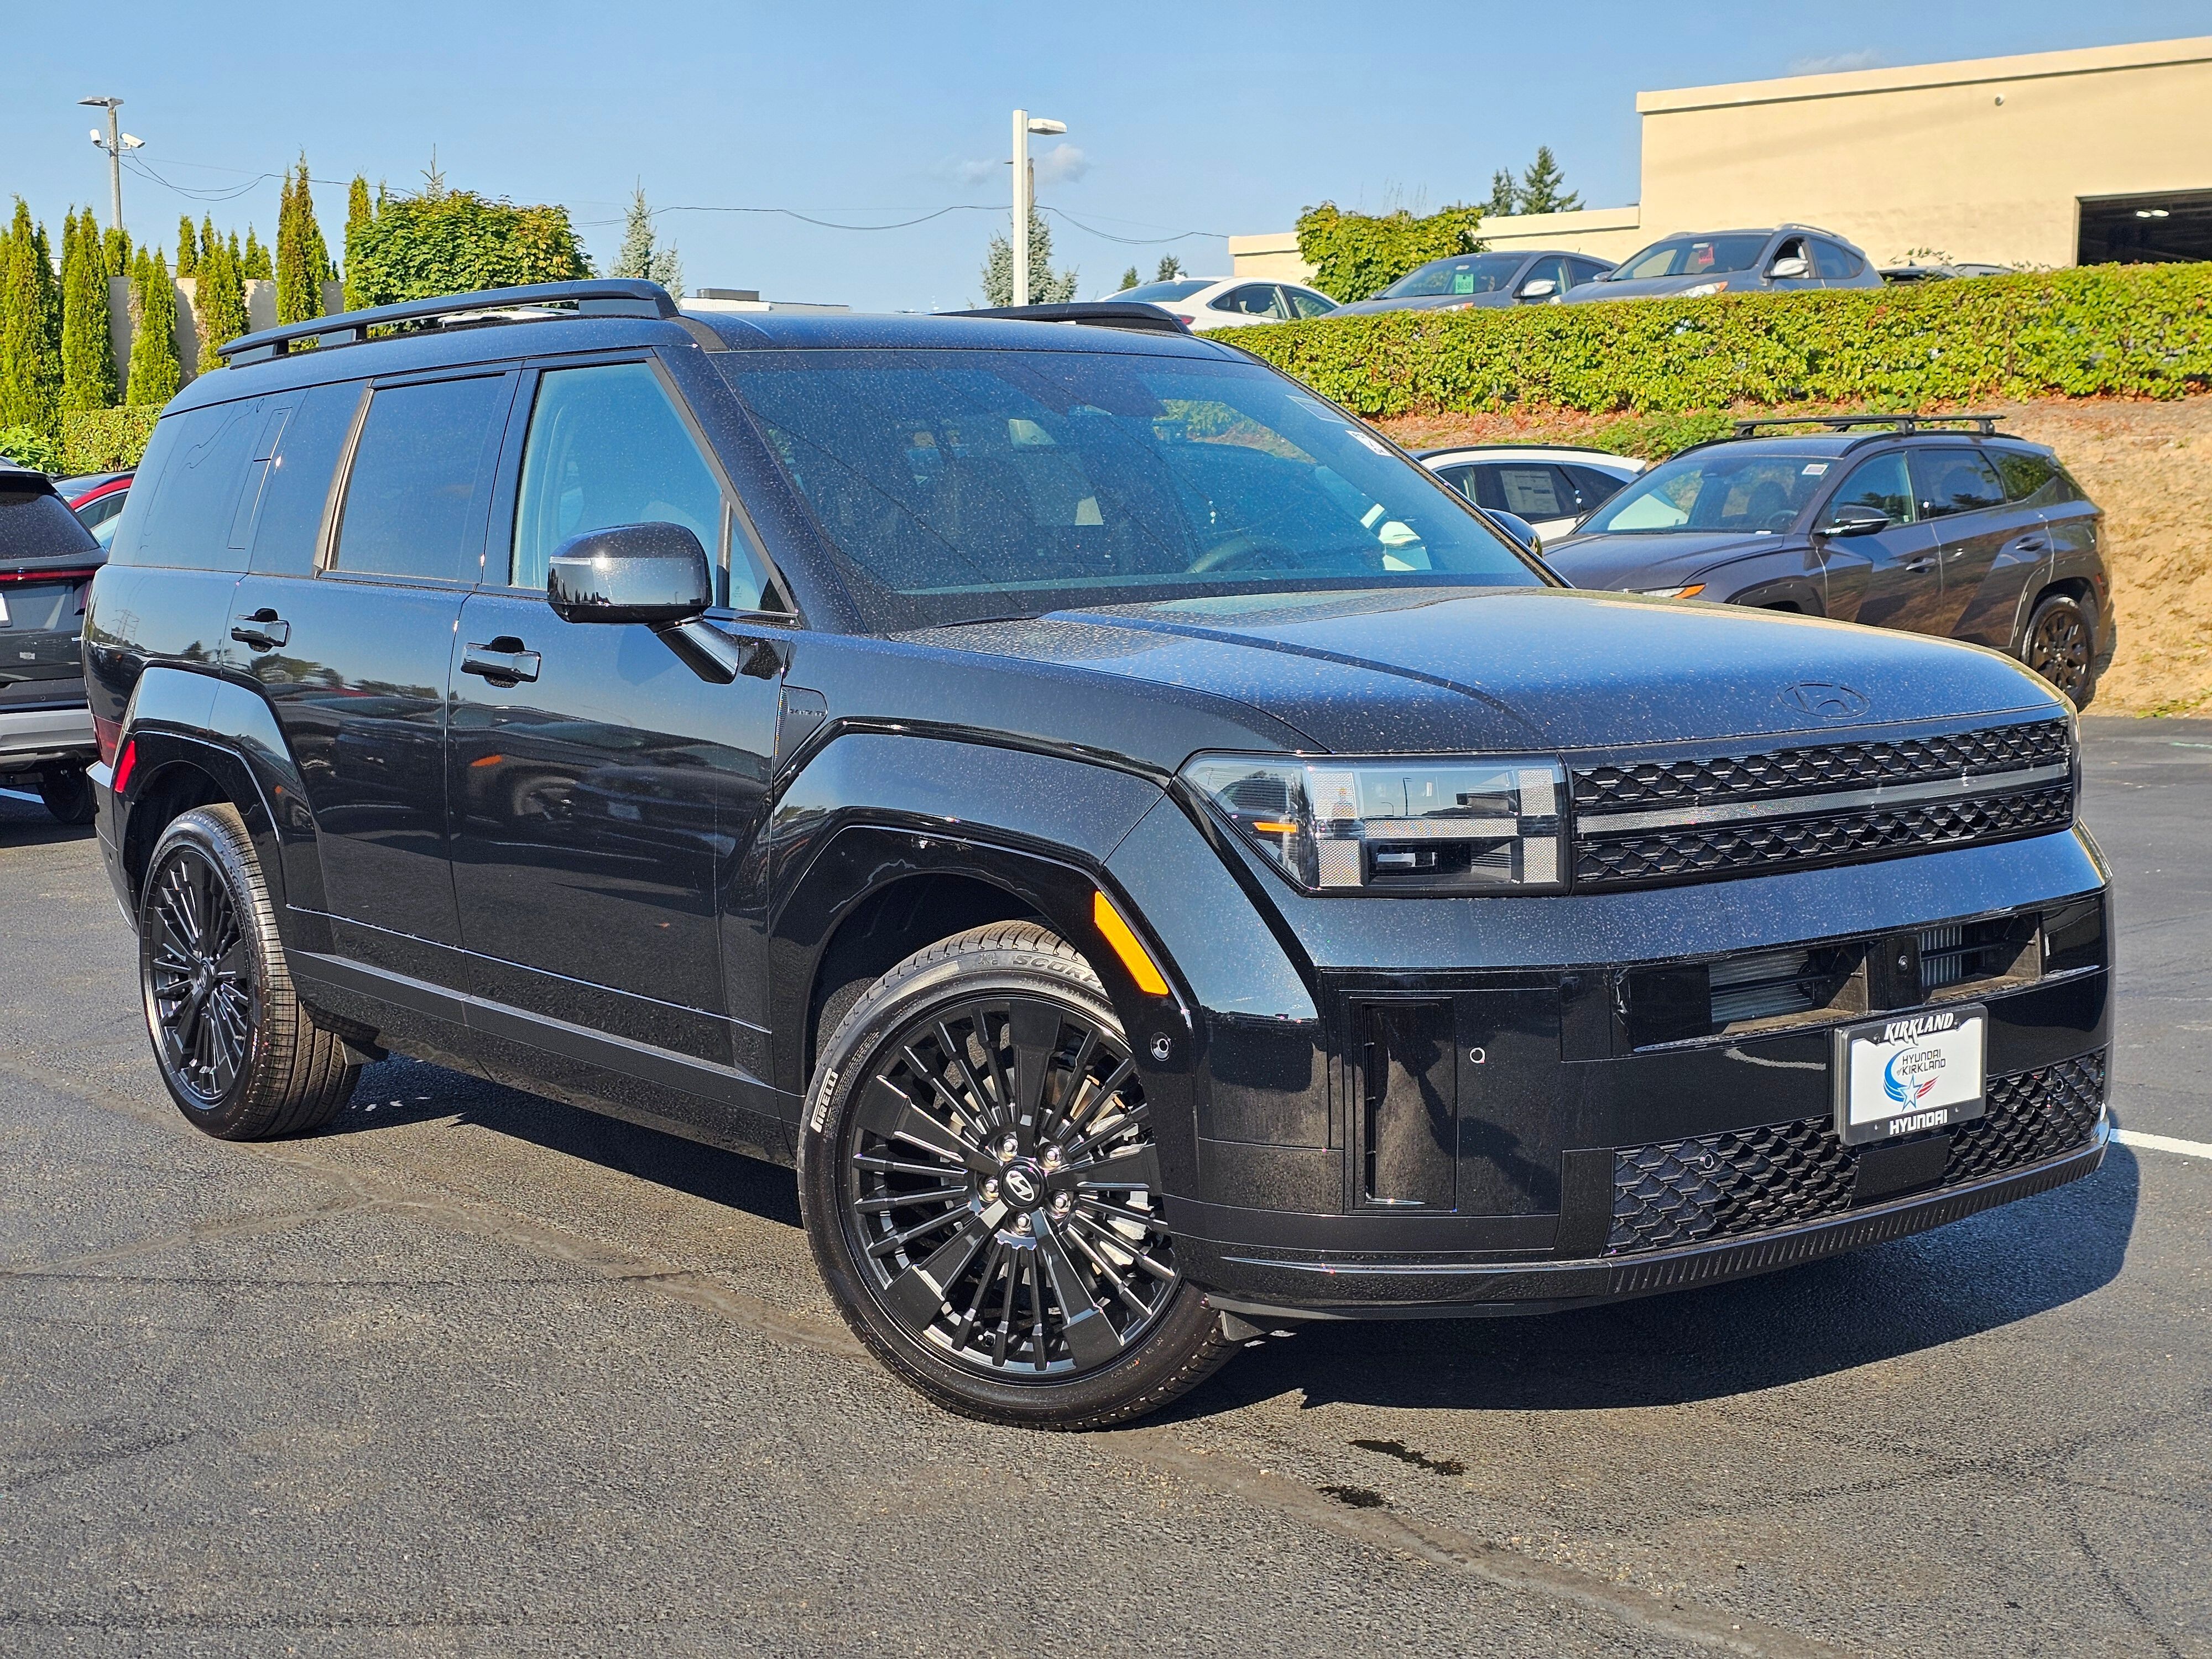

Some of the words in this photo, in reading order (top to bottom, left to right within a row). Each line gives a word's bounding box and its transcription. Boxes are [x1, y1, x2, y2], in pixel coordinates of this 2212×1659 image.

[1013, 954, 1104, 989] SCORP
[1884, 1013, 1954, 1046] KIRKLAND
[1902, 1048, 1941, 1065] HYUNDAI
[1902, 1058, 1945, 1076] KIRKLAND
[810, 1067, 839, 1133] PIRELLI
[1889, 1109, 1948, 1135] HYUNDAI
